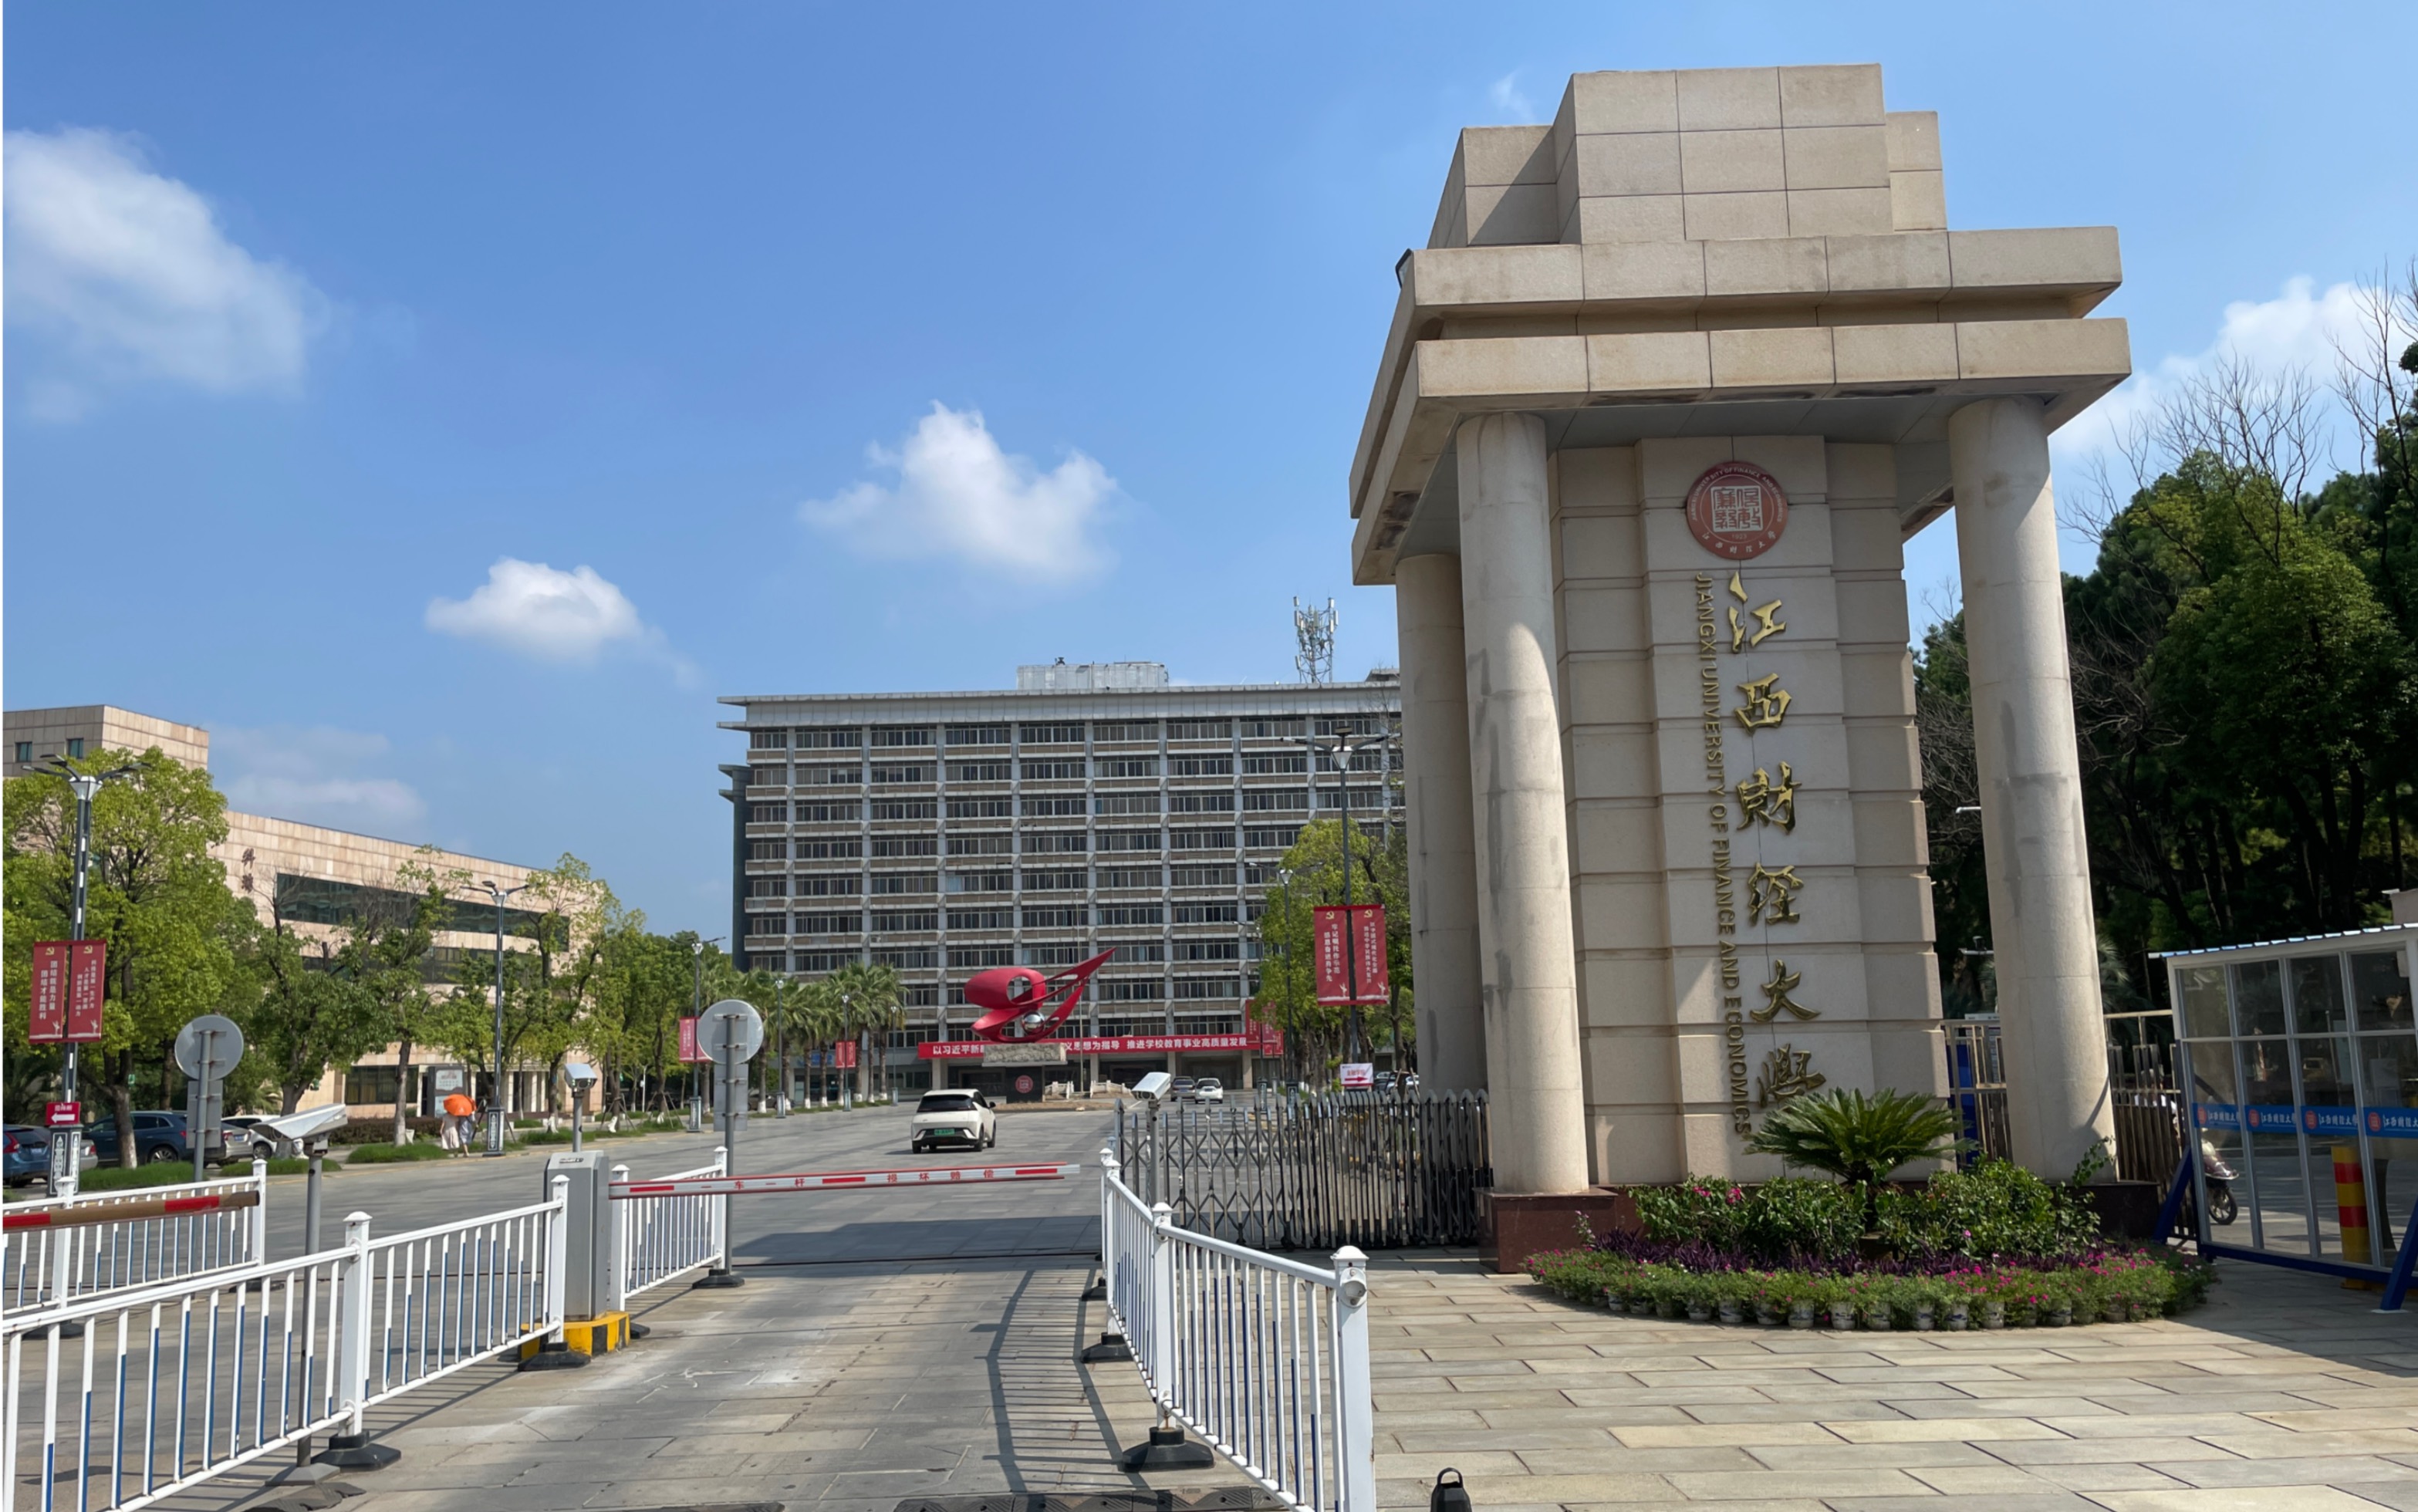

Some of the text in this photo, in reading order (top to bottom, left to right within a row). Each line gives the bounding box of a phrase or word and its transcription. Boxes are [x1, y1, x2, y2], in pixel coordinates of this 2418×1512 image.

[1696, 571, 1752, 1134] JIANGXI UNIVERSITY OF FINANCE AND ECONOMICS
[1126, 1037, 1248, 1050] 推进学校教育事业高质量发展
